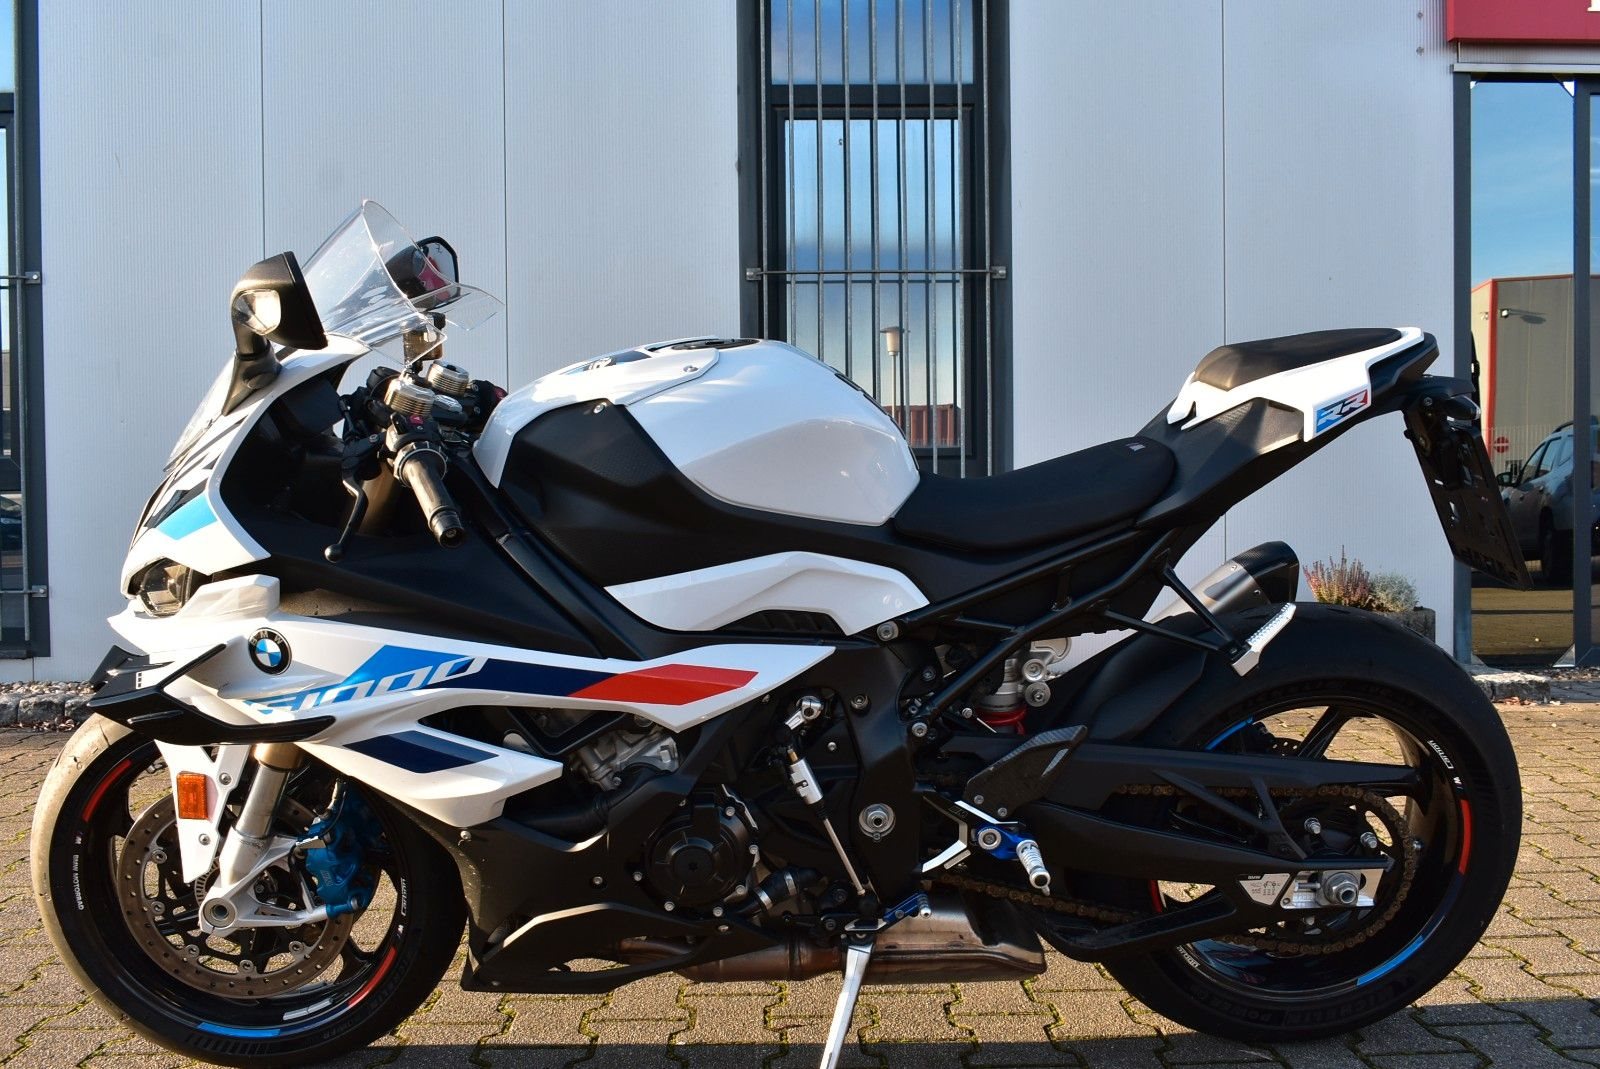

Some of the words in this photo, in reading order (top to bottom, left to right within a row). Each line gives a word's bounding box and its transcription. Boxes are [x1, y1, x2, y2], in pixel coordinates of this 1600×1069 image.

[1317, 389, 1368, 427] RR
[250, 630, 283, 646] BMW
[72, 872, 85, 911] MOTORRAD
